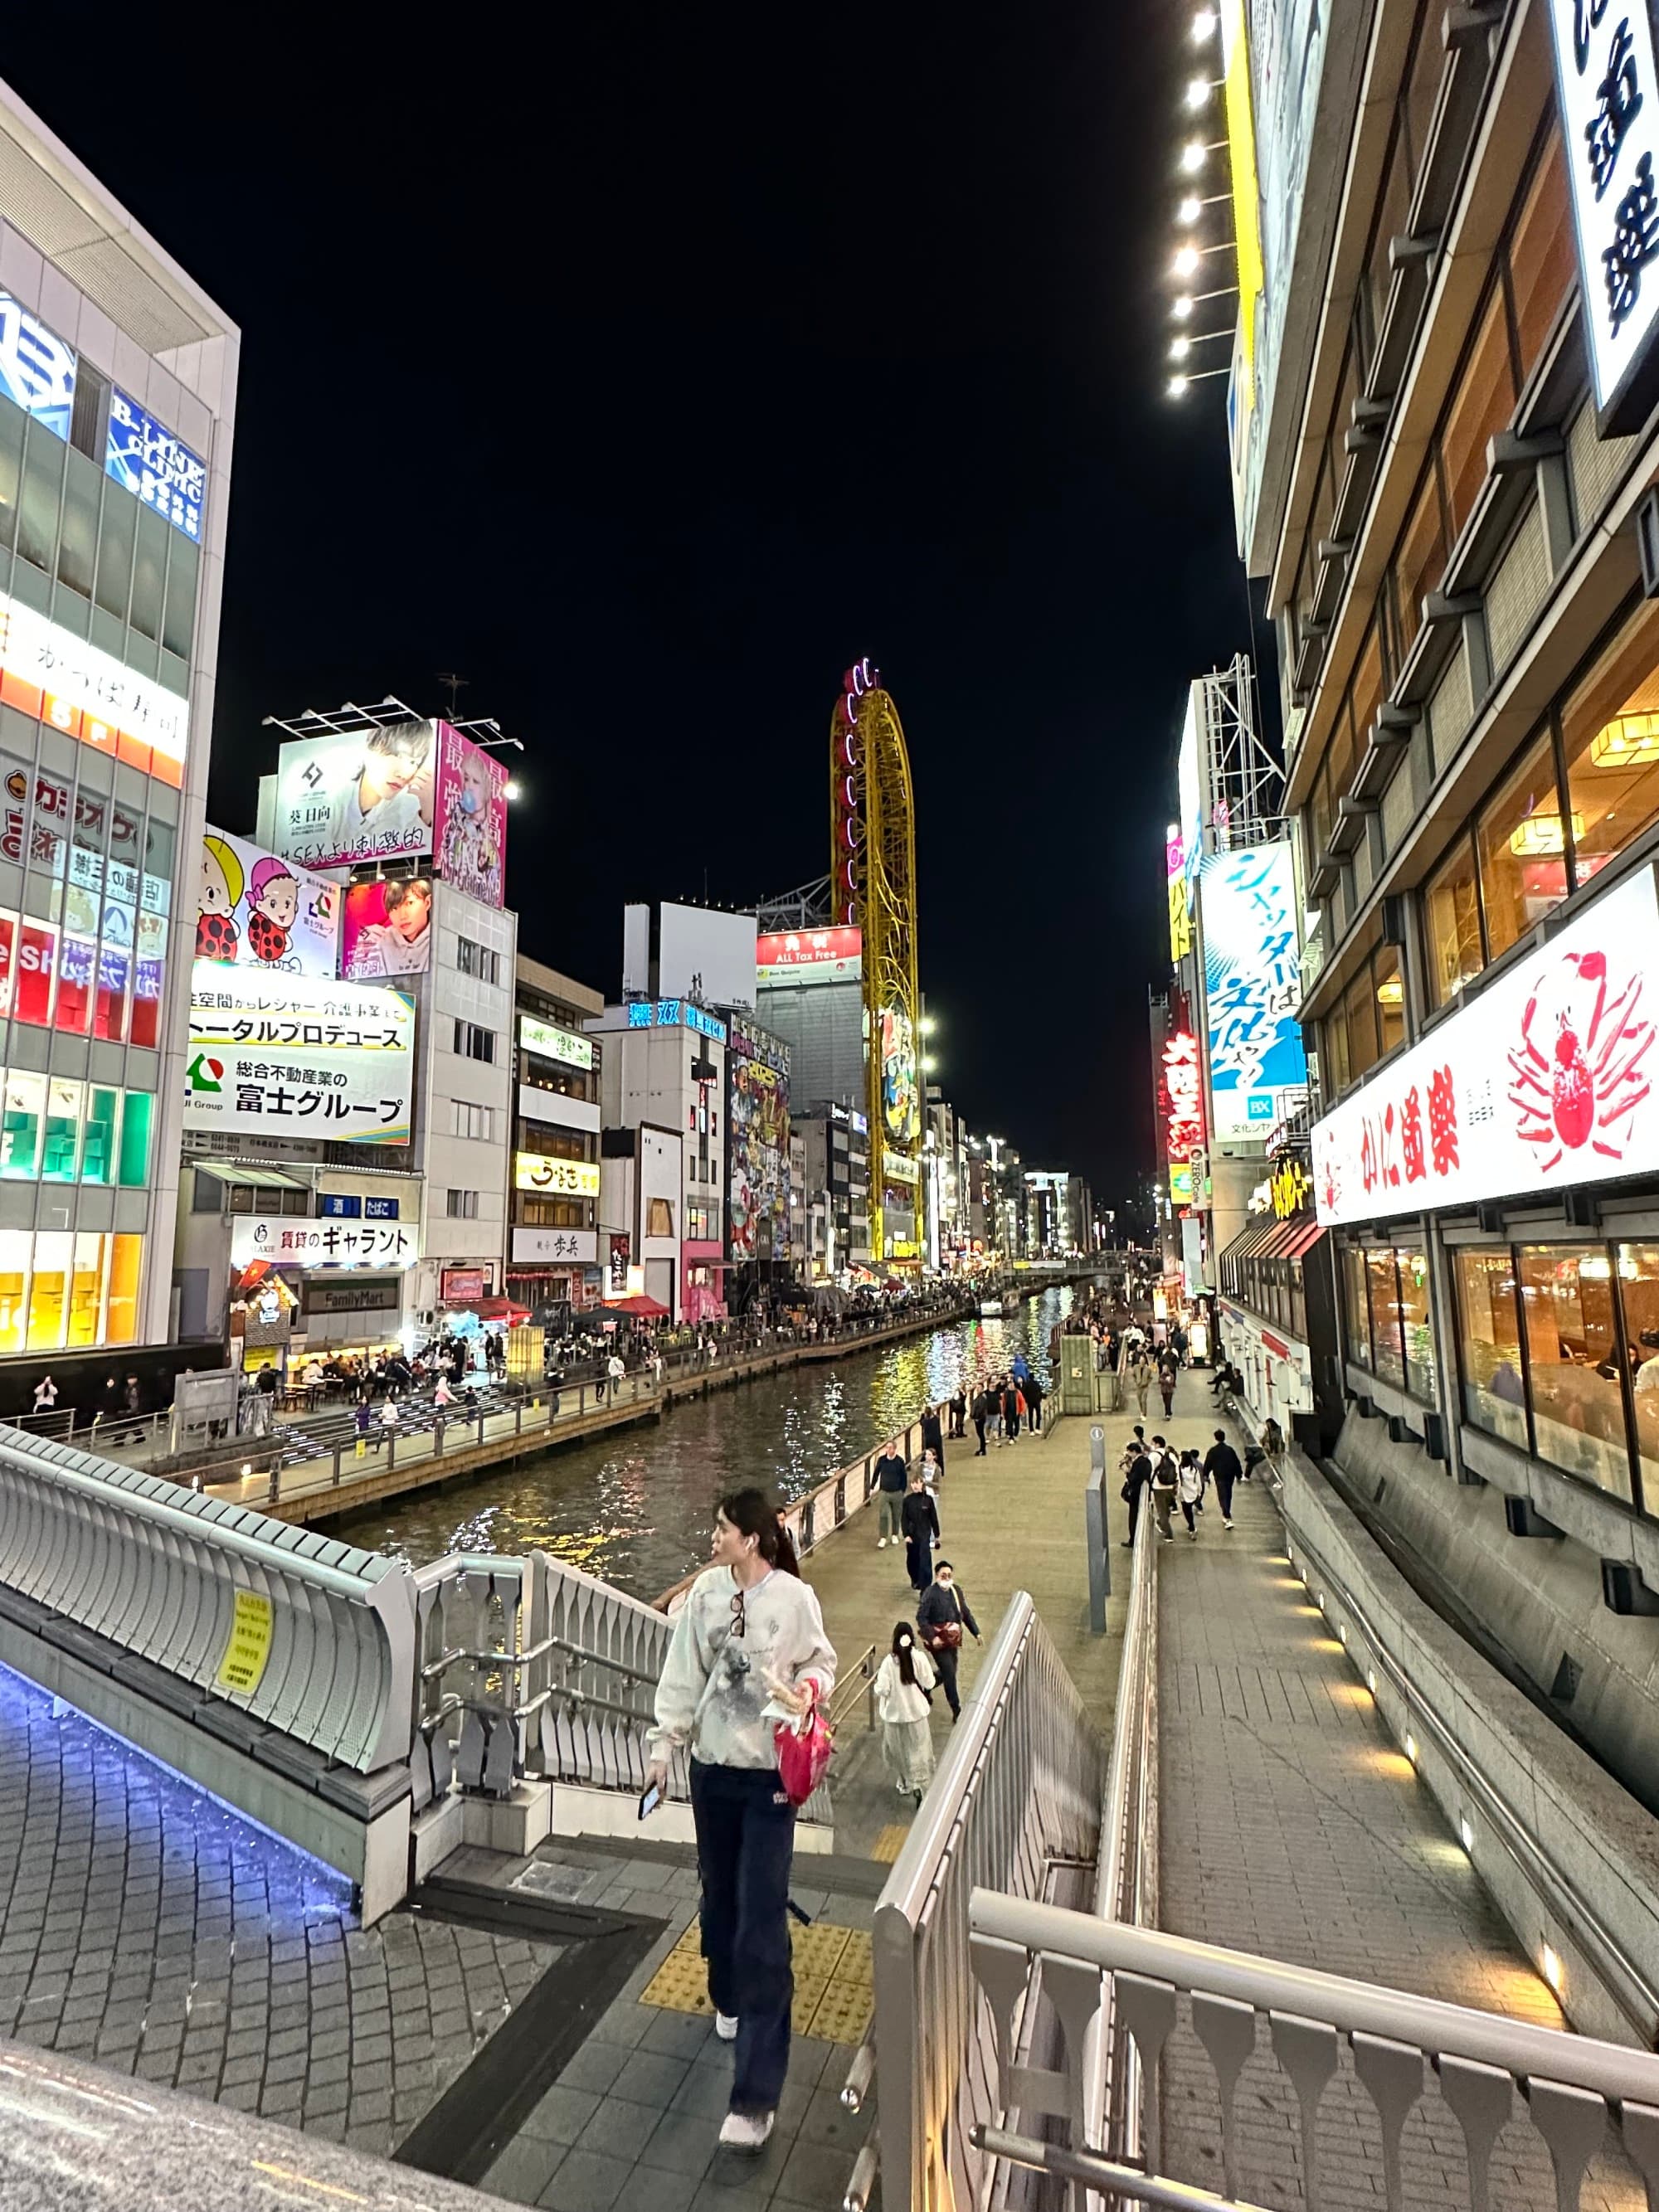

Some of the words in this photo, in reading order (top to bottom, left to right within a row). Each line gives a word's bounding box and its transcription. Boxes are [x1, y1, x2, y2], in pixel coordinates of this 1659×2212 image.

[305, 805, 331, 823] 日向
[1225, 847, 1301, 1015] シャッターは
[776, 953, 792, 963] ALL
[795, 952, 812, 962] Tax
[815, 950, 837, 960] Free
[236, 1061, 348, 1087] 総合不動産業の
[194, 1100, 224, 1111] Group
[236, 1083, 404, 1123] 富士グループ
[1250, 1101, 1271, 1113] BX
[1191, 1160, 1202, 1187] ZERO
[333, 1198, 344, 1214] 酒
[366, 1200, 389, 1216] たばこ
[280, 1225, 409, 1255] 賃貸のギャラント
[325, 1290, 384, 1307] FamilyMart
